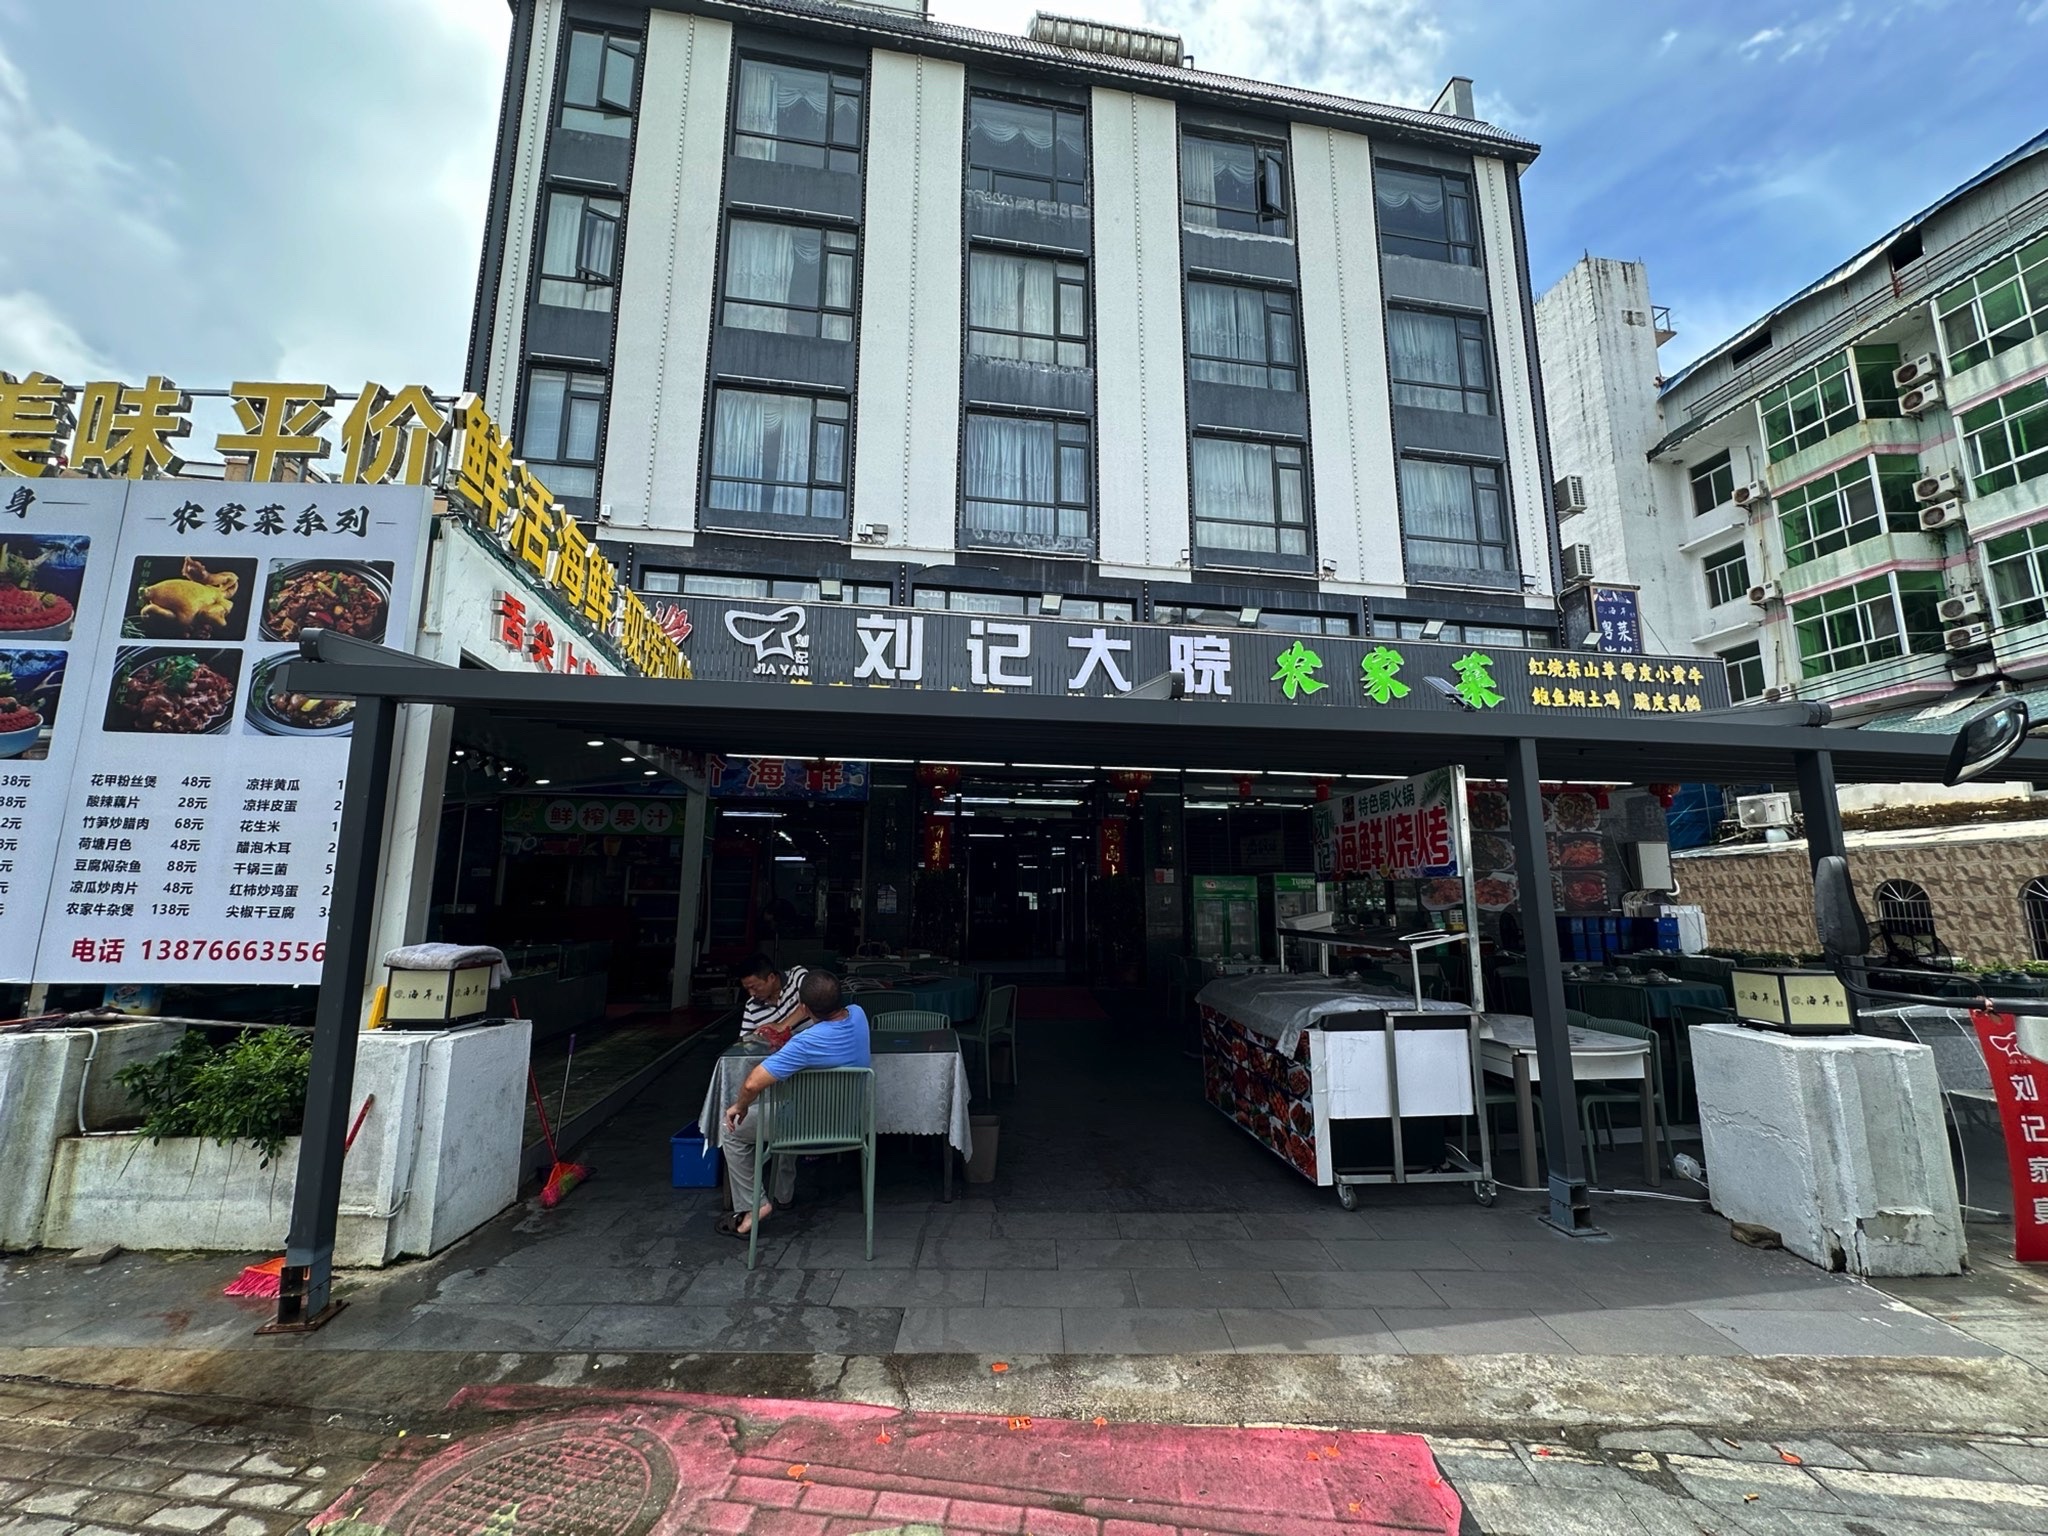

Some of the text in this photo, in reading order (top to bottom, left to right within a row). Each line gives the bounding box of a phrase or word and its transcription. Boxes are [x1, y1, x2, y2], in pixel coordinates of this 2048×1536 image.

[216, 381, 448, 485] 平价
[168, 499, 370, 538] 农家菜系列
[1601, 620, 1633, 642] 粤菜
[854, 614, 1506, 709] 刘记大院 农家菜
[753, 662, 809, 677] JIA YAN
[91, 774, 212, 788] 花甲粉丝煲 48元
[245, 778, 301, 791] 凉拌黄瓜
[86, 795, 208, 809] 酸辣藕片 28元
[242, 799, 298, 812] 凉拌皮蛋
[82, 816, 205, 831] 竹笋炒腊肉 68元
[549, 806, 668, 828] 鲜榨果汁
[240, 820, 281, 833] 花生米
[78, 837, 201, 852] 荷塘月色 48元
[1315, 810, 1331, 872] 刘记
[1334, 806, 1450, 873] 海鲜烧烤
[236, 841, 292, 854] 醋泡木耳
[73, 859, 198, 873] 豆腐焖杂鱼 88元
[233, 862, 288, 876] 干锅三菌
[69, 880, 194, 895] 凉瓜炒肉片 48元
[229, 884, 299, 897] 红柿炒鸡蛋
[66, 902, 190, 917] 农家牛杂煲 138元
[226, 905, 296, 919] 尖椒干豆腐
[71, 937, 126, 963] 电话
